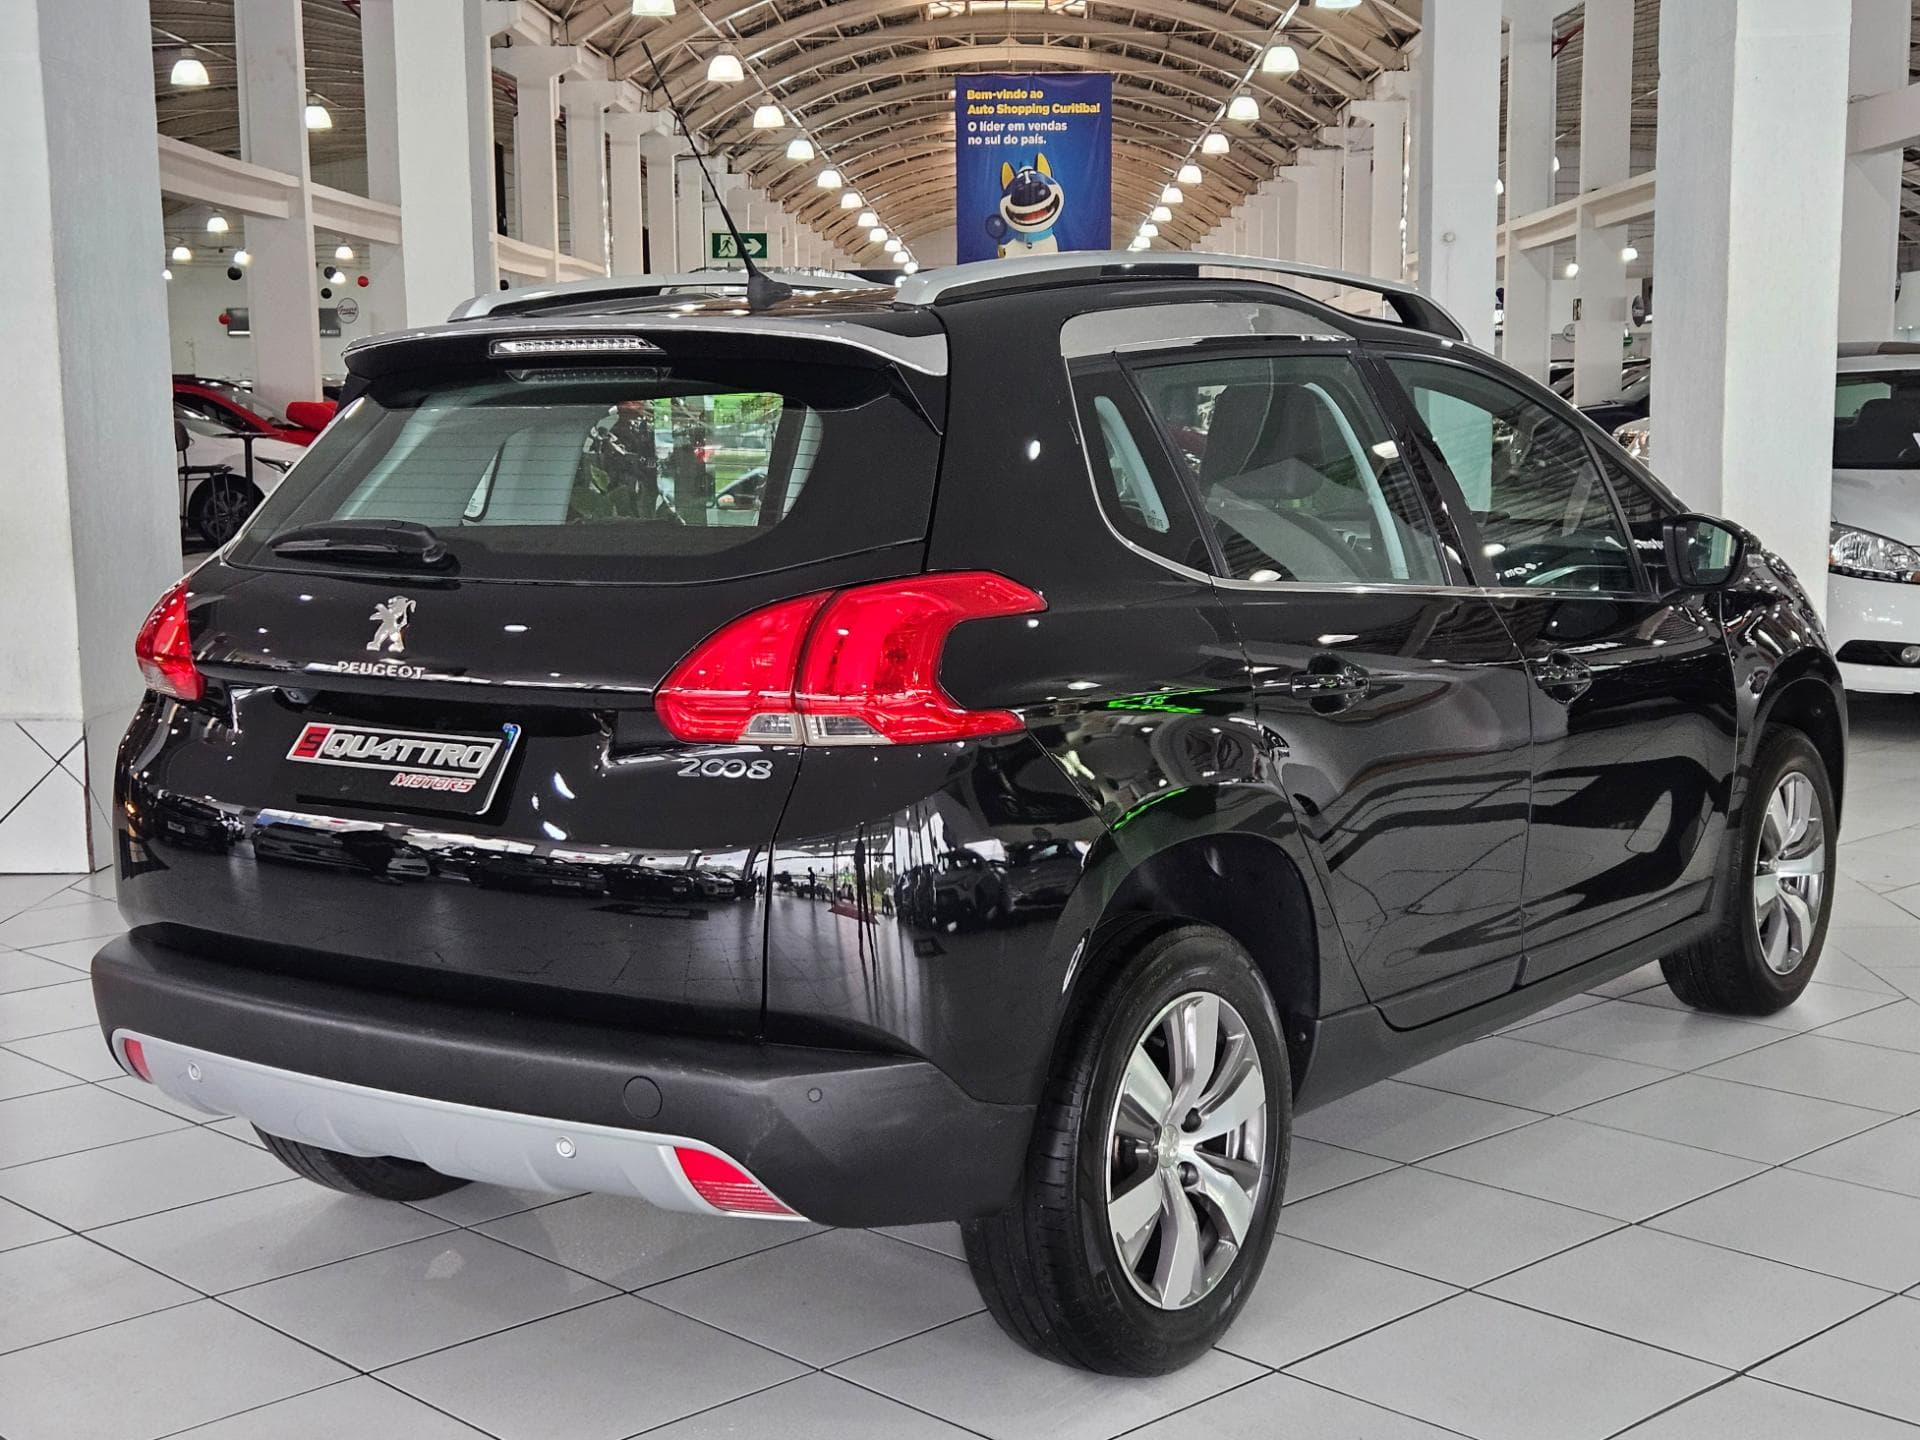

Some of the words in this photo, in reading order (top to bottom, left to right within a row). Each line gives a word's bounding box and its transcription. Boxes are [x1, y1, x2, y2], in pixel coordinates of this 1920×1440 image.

[967, 89, 1027, 99] Bem-vindo
[1030, 90, 1044, 99] ao
[967, 105, 995, 115] Auto
[997, 104, 1050, 116] Shopping
[1052, 103, 1100, 113] Curitiba!
[968, 122, 977, 132] O
[980, 121, 1005, 132] líder
[1008, 123, 1025, 131] em
[1028, 120, 1068, 131] vendas
[968, 137, 982, 145] no
[985, 135, 1001, 145] sul
[1004, 135, 1018, 145] do
[1021, 133, 1047, 146] país.
[337, 661, 426, 680] PEUGEOT
[677, 757, 774, 779] 2008
[390, 772, 476, 792] MOTORS
